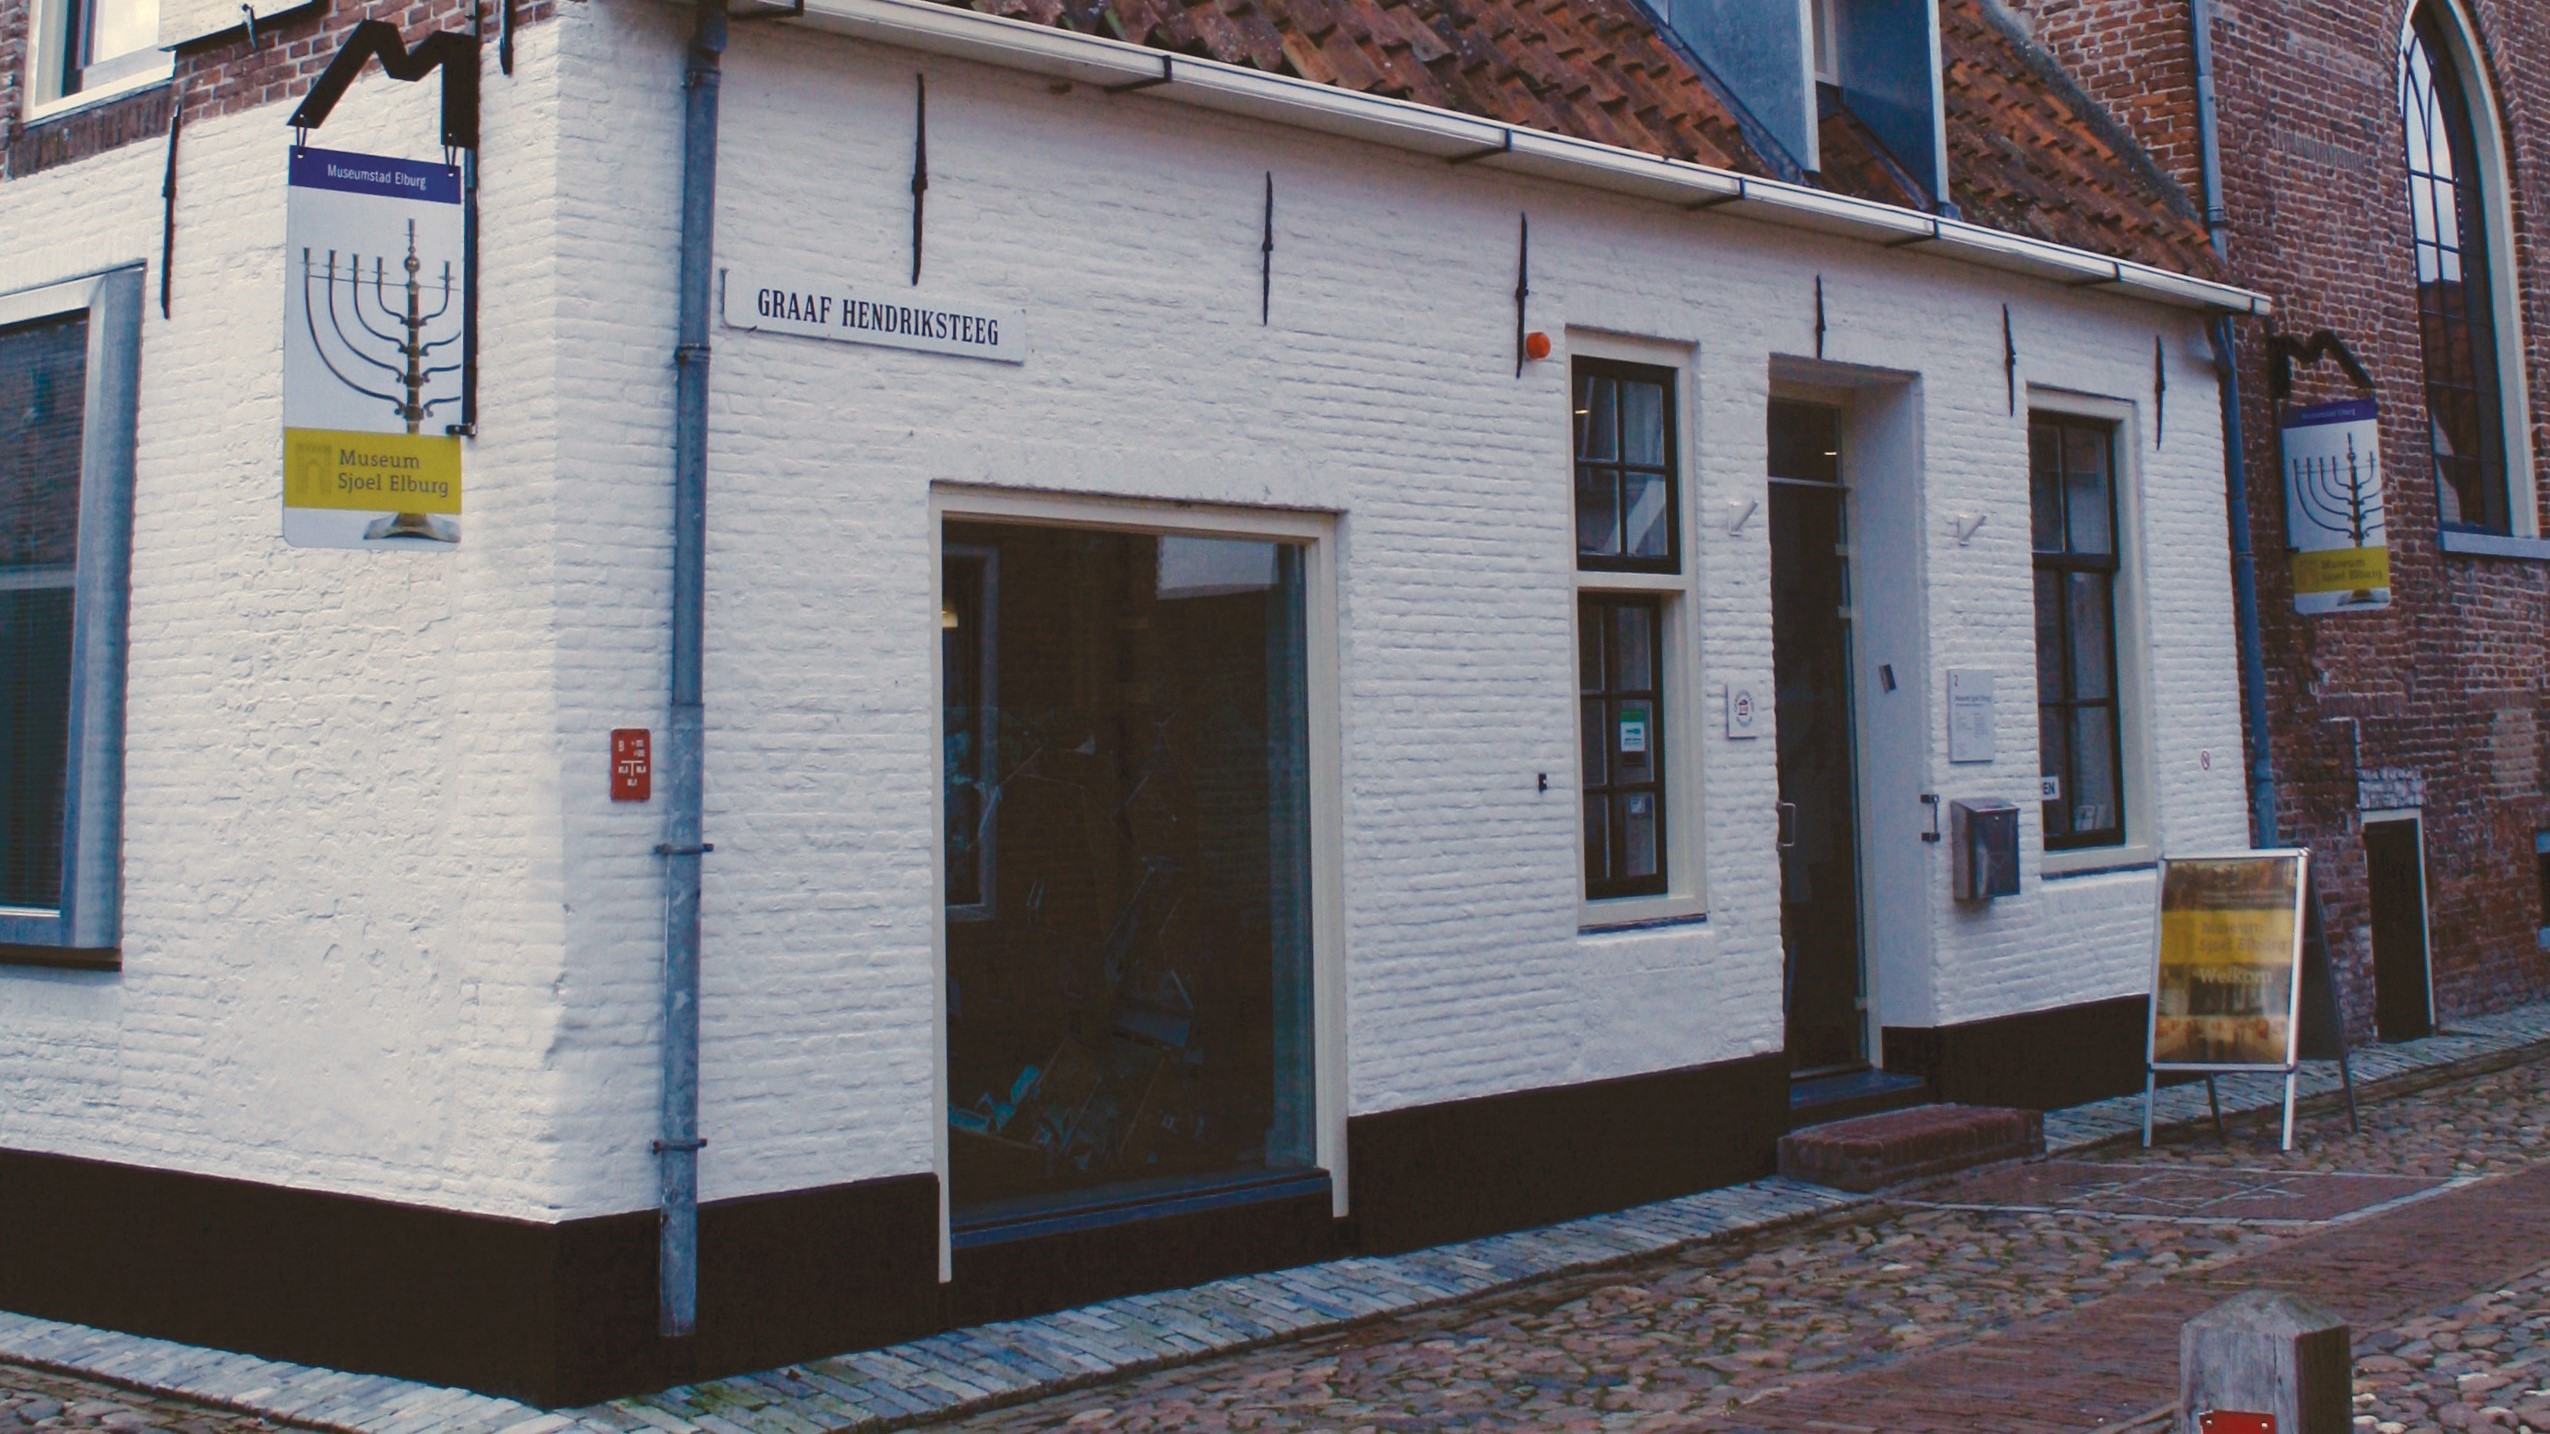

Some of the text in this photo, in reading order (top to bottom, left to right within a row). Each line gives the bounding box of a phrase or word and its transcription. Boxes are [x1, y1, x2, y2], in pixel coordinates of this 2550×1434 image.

[327, 164, 427, 191] Museumstad Elburg
[757, 288, 999, 346] GRAAF HENDRIKSTEEG
[340, 449, 420, 469] Museum
[338, 472, 448, 497] Sjoel Elburg
[2043, 781, 2055, 796] EN
[2200, 964, 2273, 984] Welkom
